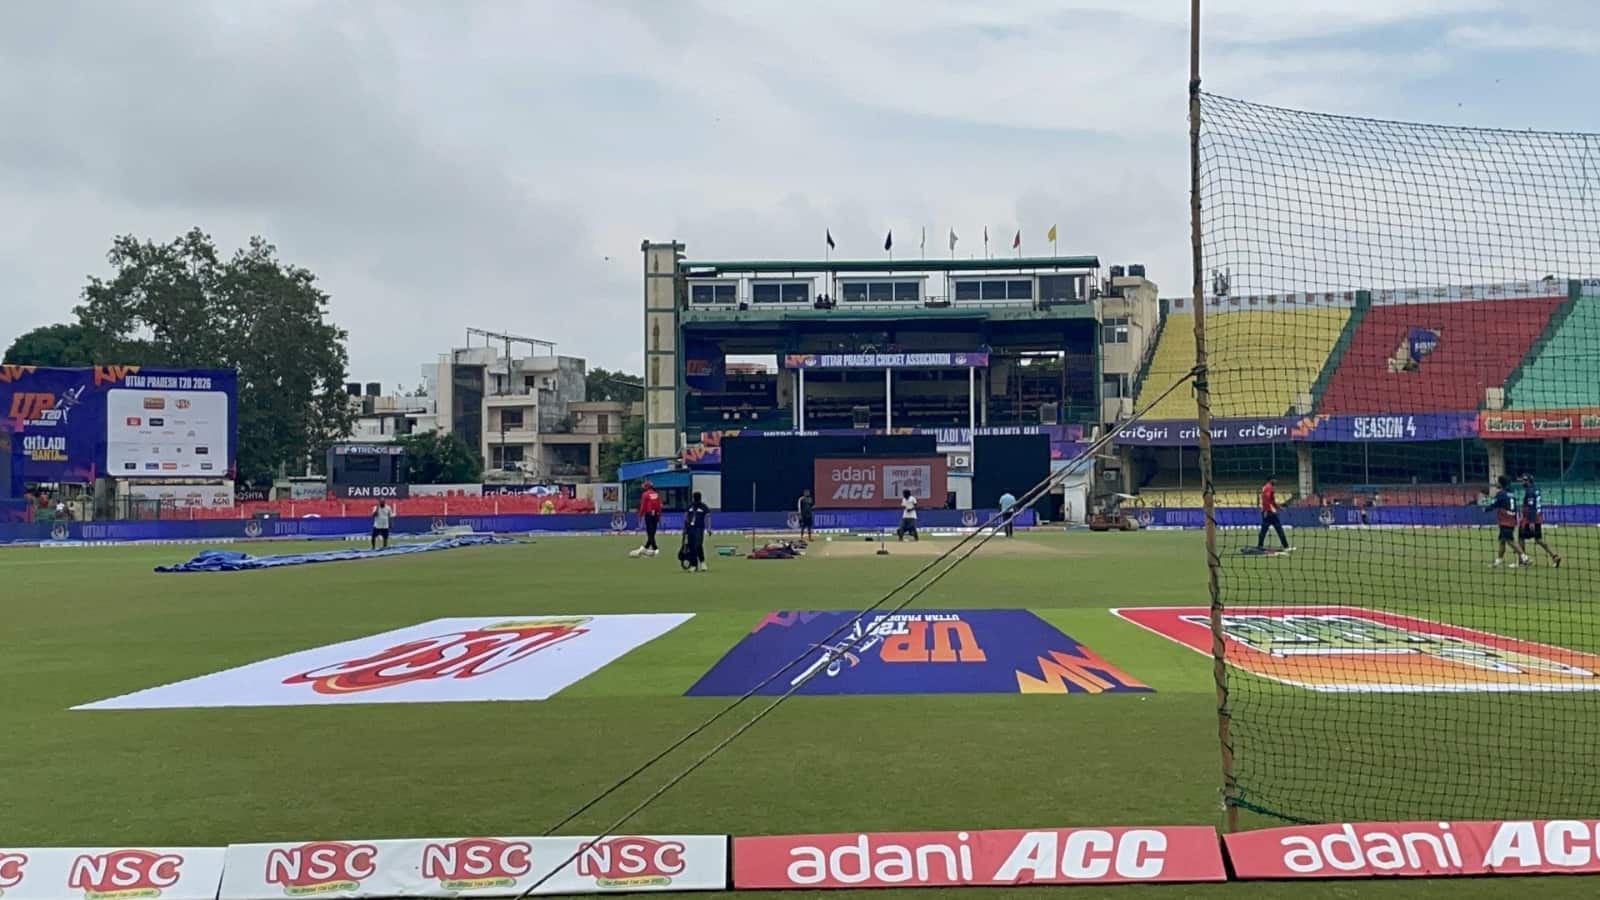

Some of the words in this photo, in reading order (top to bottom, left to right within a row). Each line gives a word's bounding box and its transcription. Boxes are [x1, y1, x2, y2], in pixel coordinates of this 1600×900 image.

[820, 354, 842, 367] UTTAR
[843, 354, 875, 367] PRADESH
[875, 353, 904, 366] CRICKET
[905, 353, 951, 366] ASSOCIATION
[125, 375, 145, 387] UTTAR
[147, 376, 178, 388] PRADESH
[179, 377, 192, 389] T20
[193, 378, 212, 390] 2026
[9, 392, 55, 419] UP
[1354, 416, 1402, 439] SEASON
[1406, 415, 1417, 438] 4
[832, 466, 876, 481] adani
[348, 487, 370, 497] FAN
[373, 487, 397, 497] BOX
[832, 484, 875, 499] ACC
[879, 620, 987, 662] UP
[423, 843, 532, 878] NSC
[578, 842, 686, 876] NSC
[787, 831, 974, 884] adani
[993, 829, 1167, 880] ACC
[1280, 822, 1462, 873] adani
[1484, 820, 1600, 867] AC
[70, 854, 184, 888] NSC
[266, 845, 377, 883] NSC
